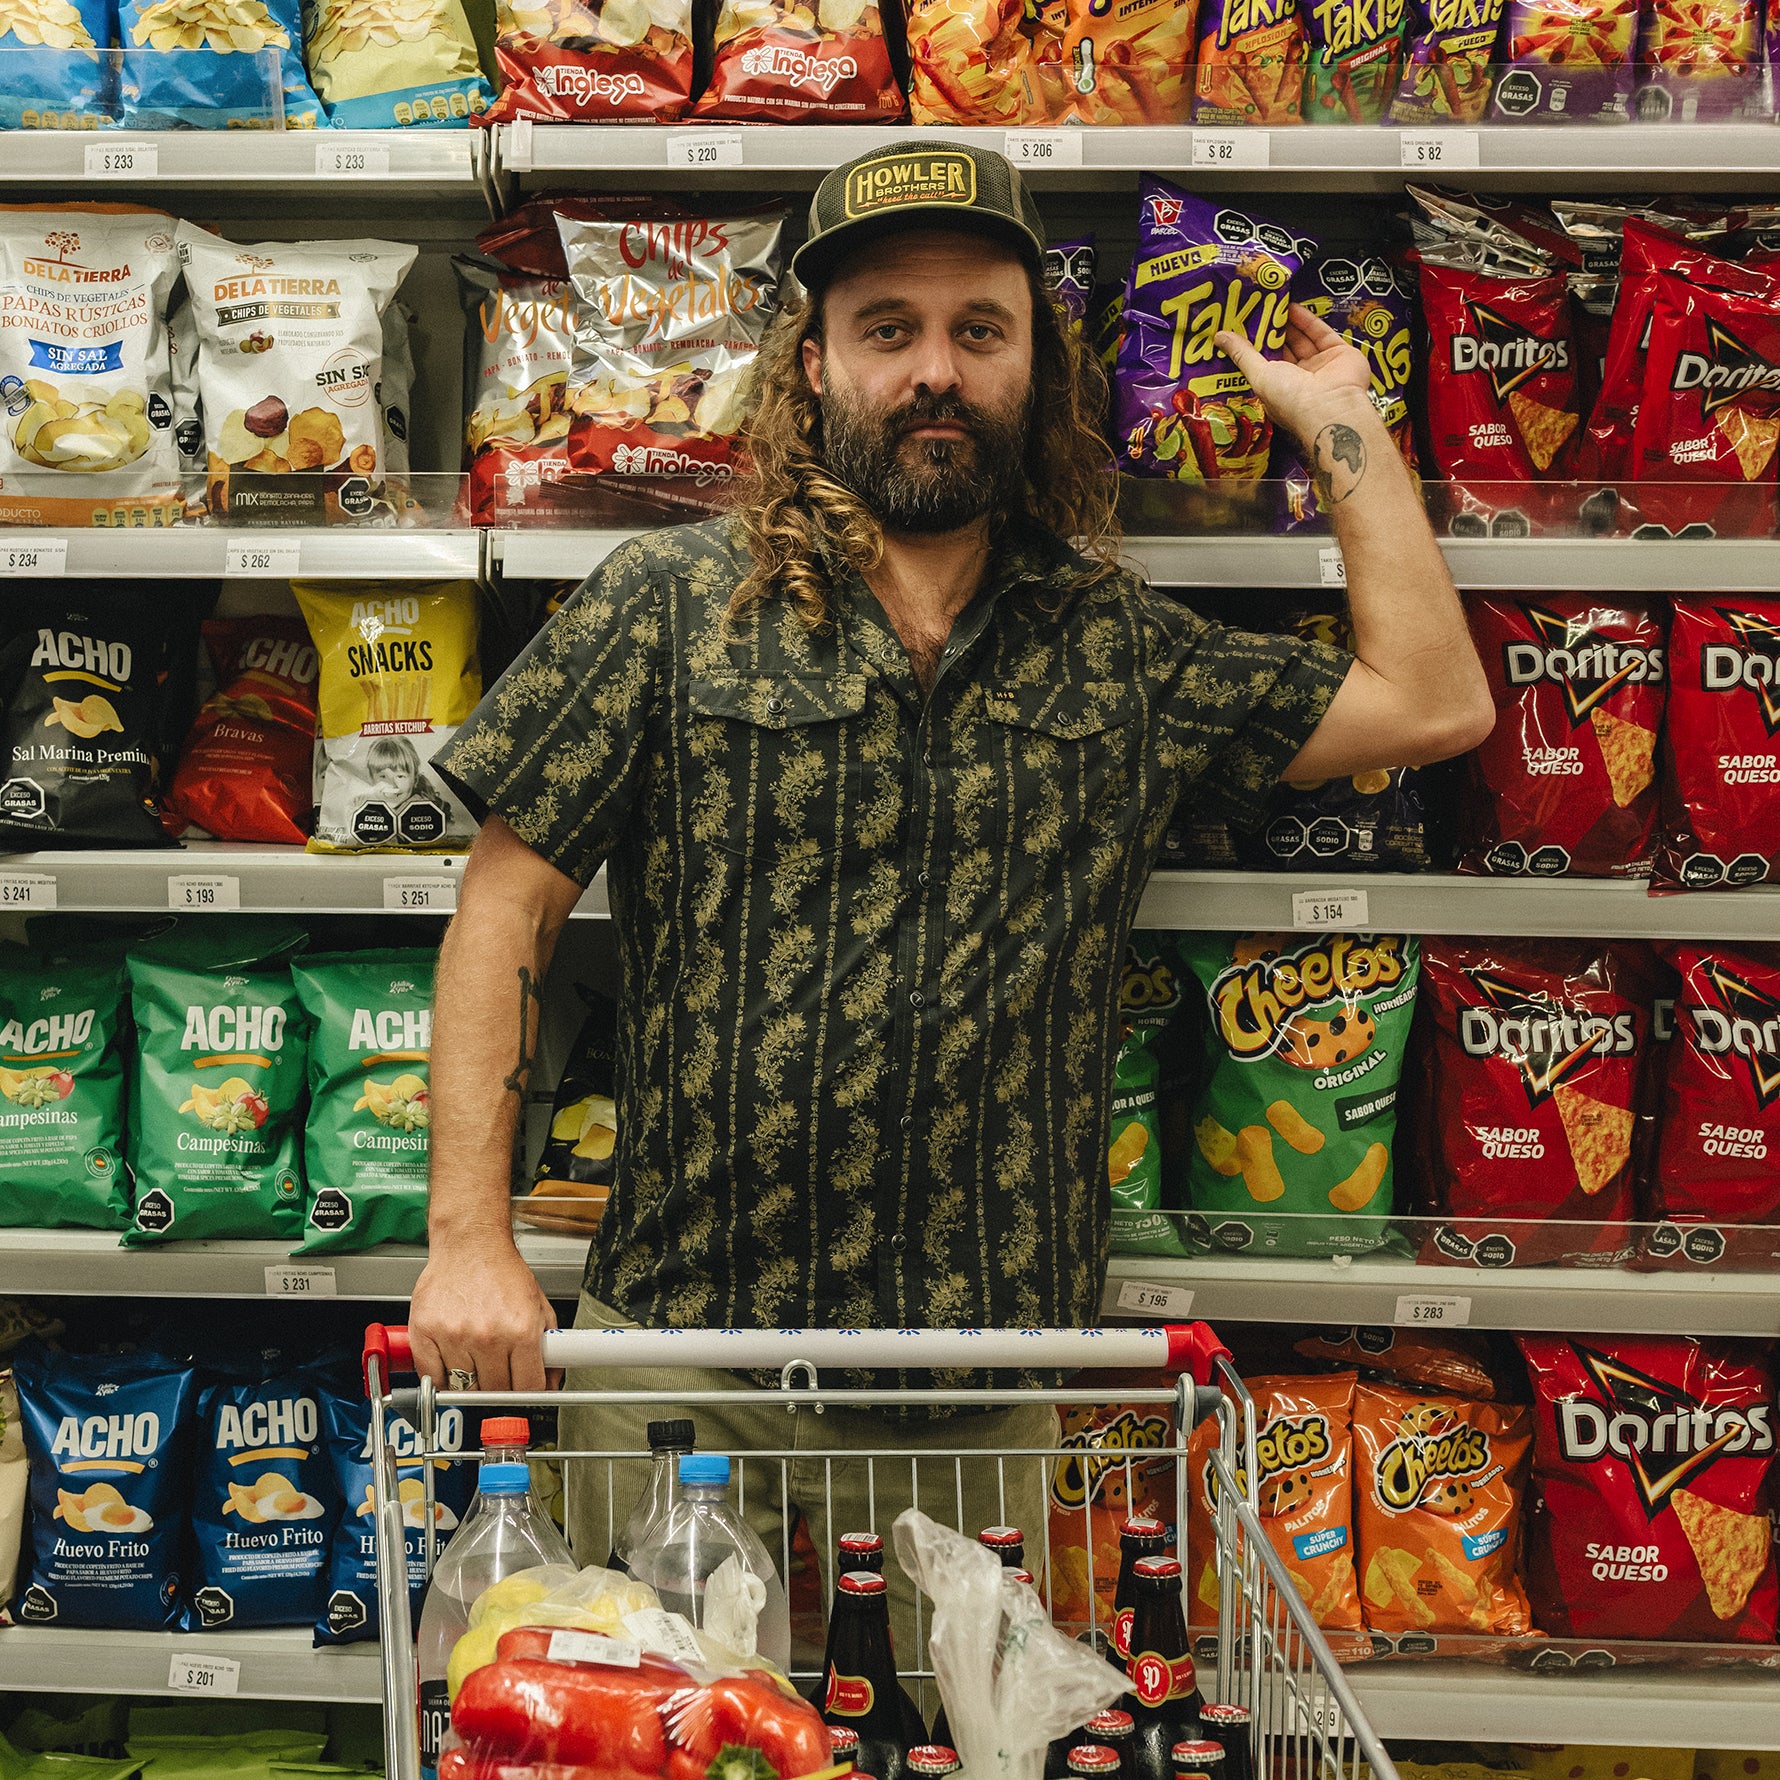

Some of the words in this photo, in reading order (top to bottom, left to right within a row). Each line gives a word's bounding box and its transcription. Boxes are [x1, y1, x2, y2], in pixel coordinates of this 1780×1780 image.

[1313, 0, 1403, 64] Takis
[1458, 36, 1487, 48] FUEGO
[780, 49, 803, 58] TIENDA
[1350, 44, 1387, 69] ORIGINAL
[772, 49, 853, 90] Inglesa
[555, 68, 641, 103] Inglesa
[1502, 91, 1534, 101] GRASAS
[698, 147, 717, 162] 220
[1033, 143, 1052, 157] 206
[1219, 145, 1232, 159] 82
[1428, 146, 1441, 160] 82
[114, 154, 133, 169] 233
[345, 154, 364, 169] 233
[857, 162, 966, 203] HOWLER
[875, 182, 945, 197] BROTHERS
[904, 192, 918, 201] the
[1220, 223, 1251, 235] GRASAS
[619, 218, 730, 270] Chips
[667, 260, 686, 281] de
[1150, 250, 1202, 277] NUEVO
[73, 264, 131, 283] TIERRA
[1325, 275, 1355, 283] GRASAS
[26, 284, 55, 299] CHIPS
[57, 294, 71, 303] DE
[73, 288, 129, 303] VEGETALES
[268, 279, 341, 296] TIERRA
[2, 295, 62, 318] PAPAS
[231, 306, 257, 319] CHIPS
[258, 305, 269, 315] DE
[273, 305, 322, 316] VEGETALES
[1, 315, 79, 338] BONIATOS
[83, 313, 148, 338] CRIOLLOS
[670, 339, 715, 350] REMOLACHA
[48, 347, 73, 361] SIN
[78, 348, 108, 361] SAL
[1453, 335, 1569, 374] Doritos
[50, 361, 106, 371] AGREGADA
[315, 368, 345, 387] SIN
[150, 409, 170, 418] GRASAS
[1468, 423, 1507, 437] SABOR
[1473, 435, 1513, 449] QUESO
[1669, 438, 1709, 453] SABOR
[652, 450, 676, 459] TIENDA
[1673, 449, 1717, 465] QUESO
[235, 492, 259, 506] MIX
[18, 553, 38, 567] 234
[251, 554, 270, 568] 262
[351, 597, 420, 628] ACHO
[31, 628, 132, 682] ACHO
[347, 640, 433, 678] SNACKS
[1507, 642, 1663, 684] Doritos
[214, 724, 264, 743] Bravas
[363, 722, 394, 735] BARRITAS
[394, 721, 427, 734] KETCHUP
[12, 745, 34, 762] Sal
[39, 745, 93, 763] Marina
[1521, 747, 1580, 761] SABOR
[1718, 754, 1776, 769] SABOR
[1526, 762, 1584, 776] QUESO
[1723, 770, 1780, 785] QUESO
[4, 799, 37, 807] GRASAS
[10, 791, 31, 799] EXCESO
[358, 822, 389, 831] GRASAS
[409, 823, 433, 831] SODIO
[1315, 836, 1339, 844] SODIO
[1491, 856, 1521, 869] GRASAS
[13, 886, 31, 901] 241
[196, 889, 214, 904] 193
[411, 890, 429, 906] 251
[1323, 904, 1343, 919] 154
[1219, 935, 1401, 1052] Cheetos
[0, 1009, 96, 1055] ACHO
[180, 1004, 288, 1051] ACHO
[348, 1008, 430, 1051] ACH
[1461, 1007, 1634, 1055] Doritos
[1313, 1049, 1388, 1090] ORIGINAL
[0, 1108, 79, 1130] ampesinas
[1344, 1101, 1375, 1121] SABOR
[1476, 1126, 1541, 1145] SABOR
[1699, 1122, 1765, 1145] SABOR
[176, 1131, 266, 1157] Campesinas
[1481, 1142, 1545, 1160] QUESO
[1703, 1139, 1767, 1160] QUESO
[319, 1201, 339, 1209] EXCESO
[139, 1209, 167, 1218] GRASAS
[1440, 1236, 1469, 1256] GRASAS
[1691, 1243, 1715, 1253] SODIO
[292, 1277, 311, 1291] 231
[1149, 1294, 1168, 1307] 195
[1423, 1306, 1443, 1319] 283
[216, 1398, 319, 1448] ACHO
[1560, 1401, 1773, 1457] Doritos
[51, 1411, 160, 1458] ACHO
[1379, 1424, 1488, 1505] Cheetos
[1284, 1498, 1325, 1532] PALITOS
[1452, 1507, 1489, 1532] PALITOS
[224, 1530, 279, 1549] Huevo
[281, 1527, 324, 1546] Frito
[1303, 1535, 1344, 1556] CRUNCHY
[52, 1537, 105, 1558] Huevo
[108, 1540, 149, 1558] Frito
[1472, 1538, 1505, 1556] CRUNCHY
[1585, 1542, 1660, 1564] SABOR
[1592, 1562, 1669, 1583] QUESO
[1351, 1647, 1372, 1656] 110
[196, 1671, 215, 1686] 201
[1143, 1665, 1160, 1695] P
